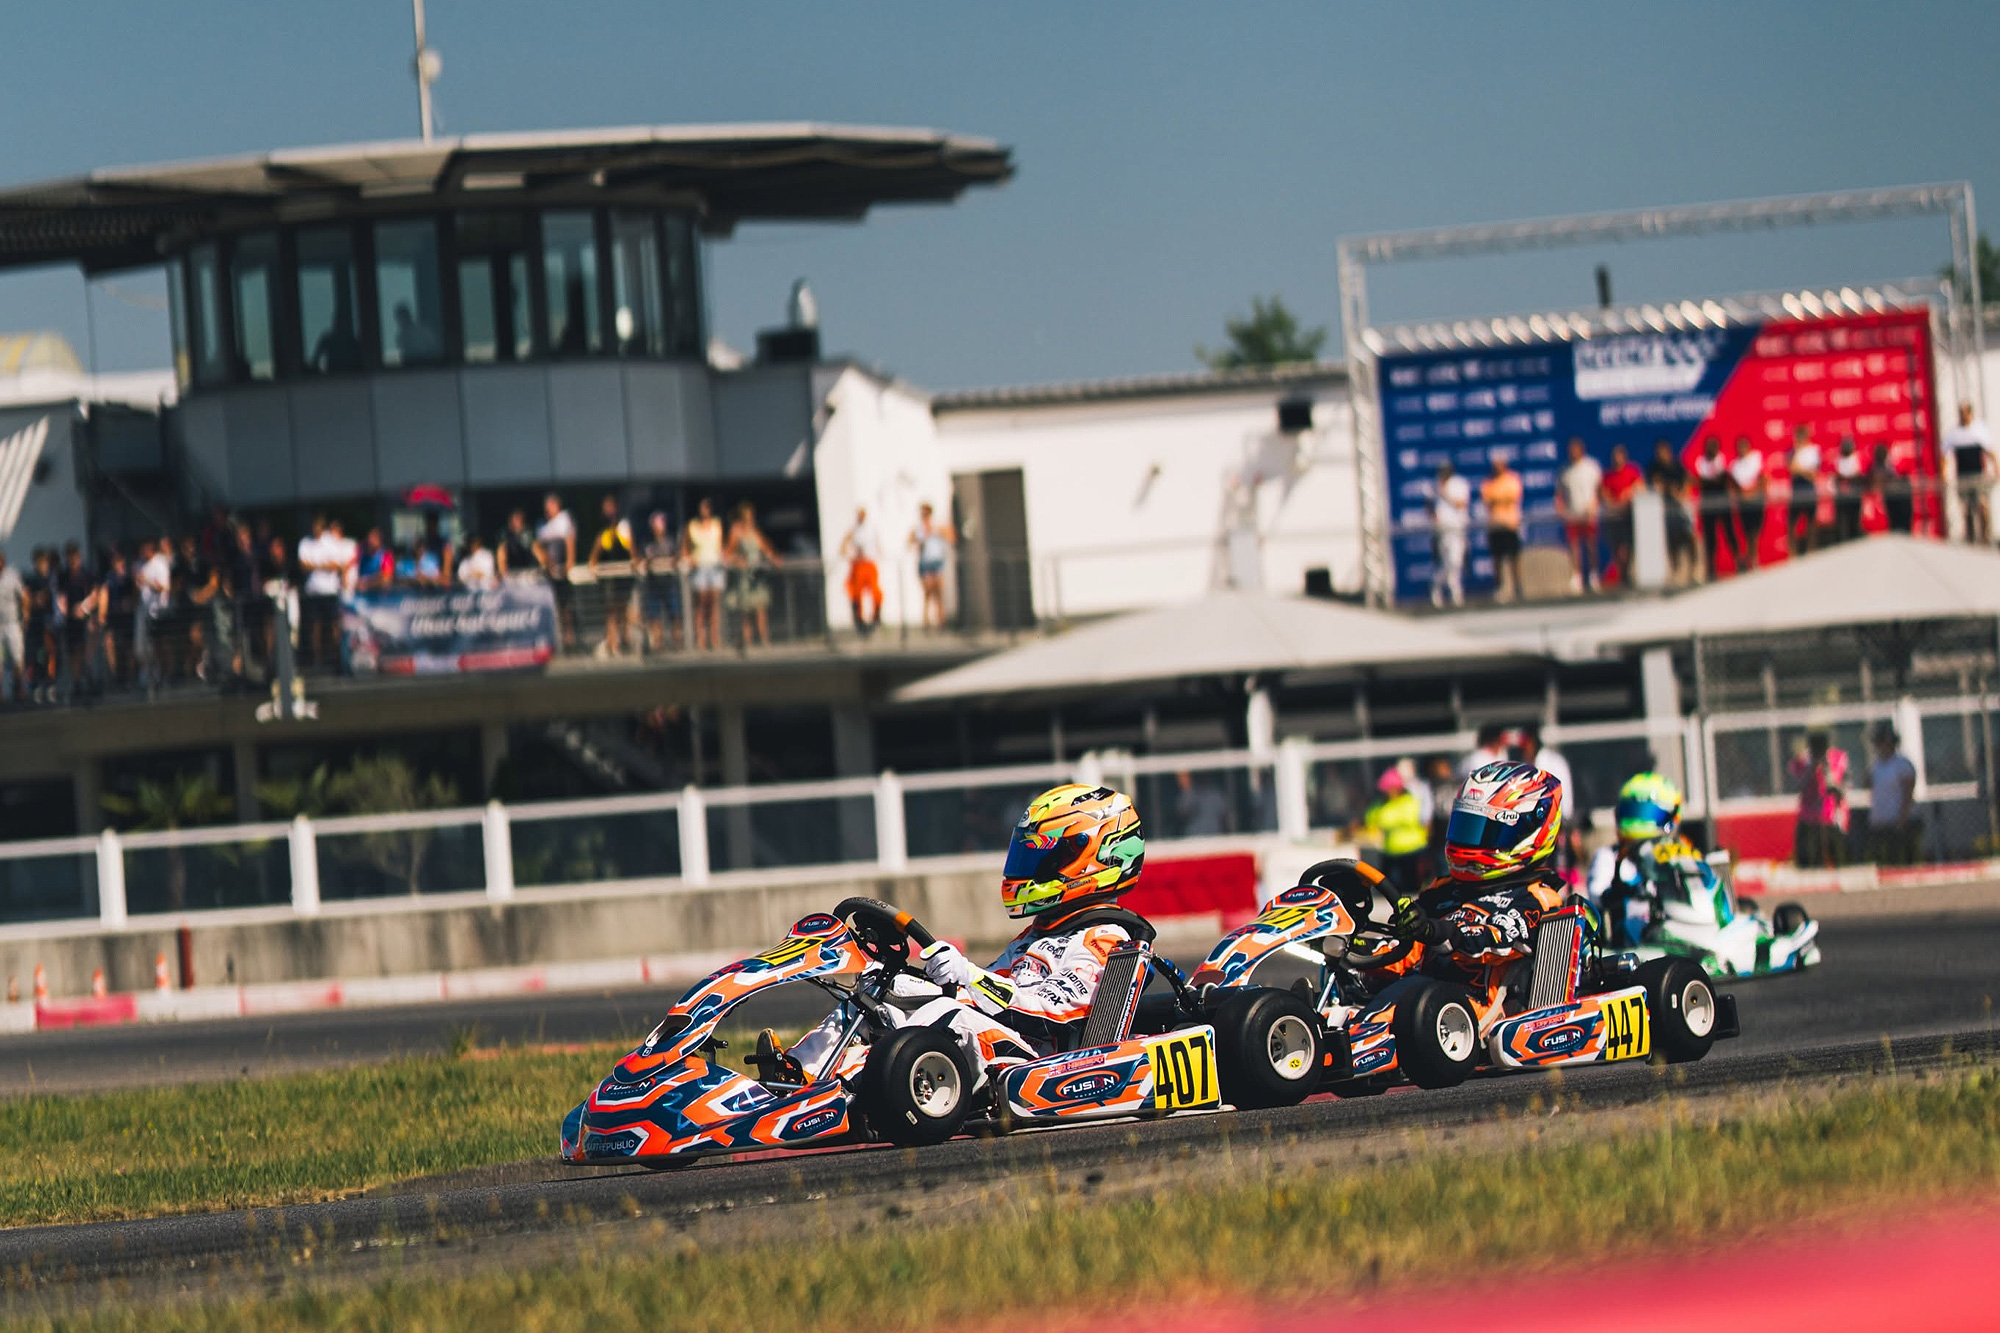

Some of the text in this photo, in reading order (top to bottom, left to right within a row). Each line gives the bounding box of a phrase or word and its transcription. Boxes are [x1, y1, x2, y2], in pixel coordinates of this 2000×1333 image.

[1495, 810, 1519, 822] Arai
[1607, 996, 1644, 1059] 447
[1155, 1035, 1209, 1109] 407
